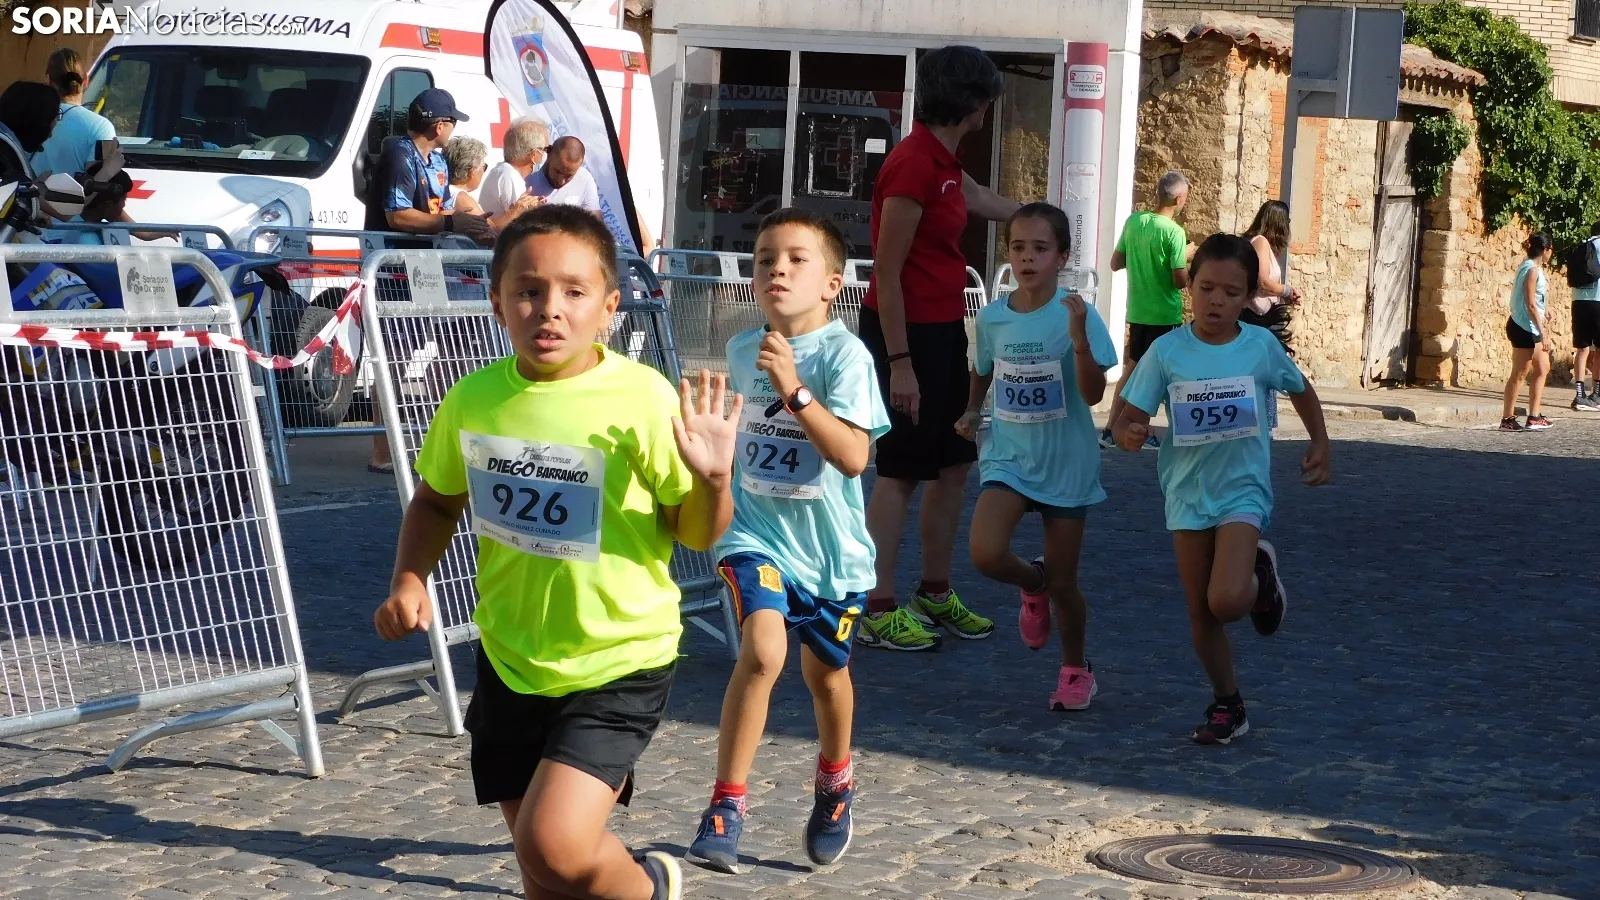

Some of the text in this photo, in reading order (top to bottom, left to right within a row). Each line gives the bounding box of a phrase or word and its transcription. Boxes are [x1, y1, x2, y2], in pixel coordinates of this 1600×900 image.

[1073, 214, 1082, 250] Redonda
[1003, 373, 1054, 384] DIEGO BARRANCO
[1005, 387, 1047, 407] 968
[1186, 390, 1247, 403] DIEGO BARRANCO
[1190, 404, 1238, 427] 959
[745, 420, 809, 441] DIEGO BARRANC
[745, 441, 800, 474] 924
[487, 457, 589, 484] DIEGO BARRANCO
[492, 483, 568, 526] 926
